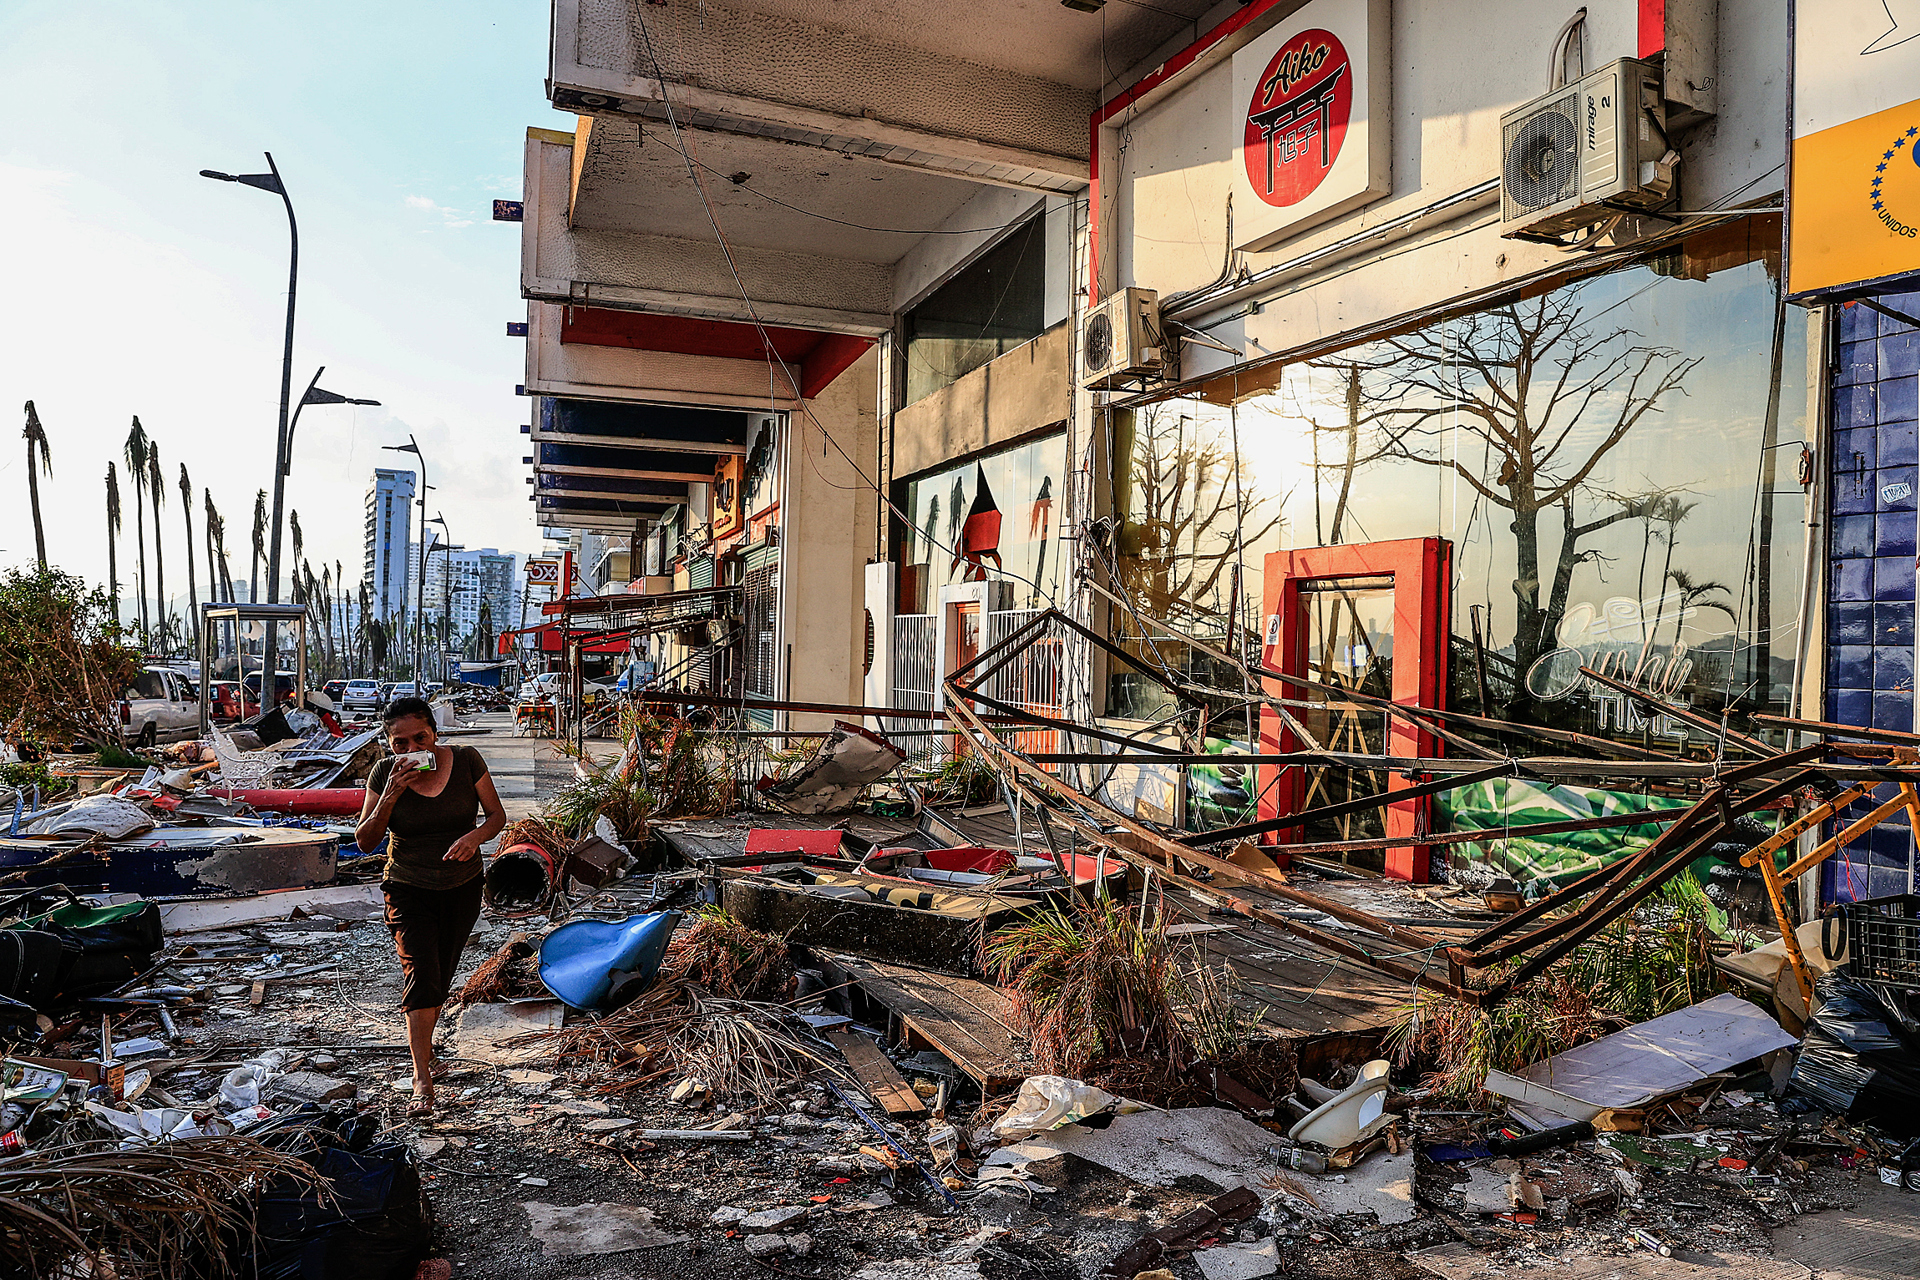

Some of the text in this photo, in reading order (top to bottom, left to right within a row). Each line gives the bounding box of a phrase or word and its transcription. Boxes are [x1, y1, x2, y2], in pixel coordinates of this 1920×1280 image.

[1262, 42, 1330, 106] Aiko
[1584, 95, 1597, 151] mirage
[1601, 95, 1611, 109] 2
[1277, 118, 1319, 168] 旭子
[1877, 208, 1918, 238] UNIDOS
[1526, 604, 1692, 700] Sushi
[1590, 694, 1691, 740] TIME
